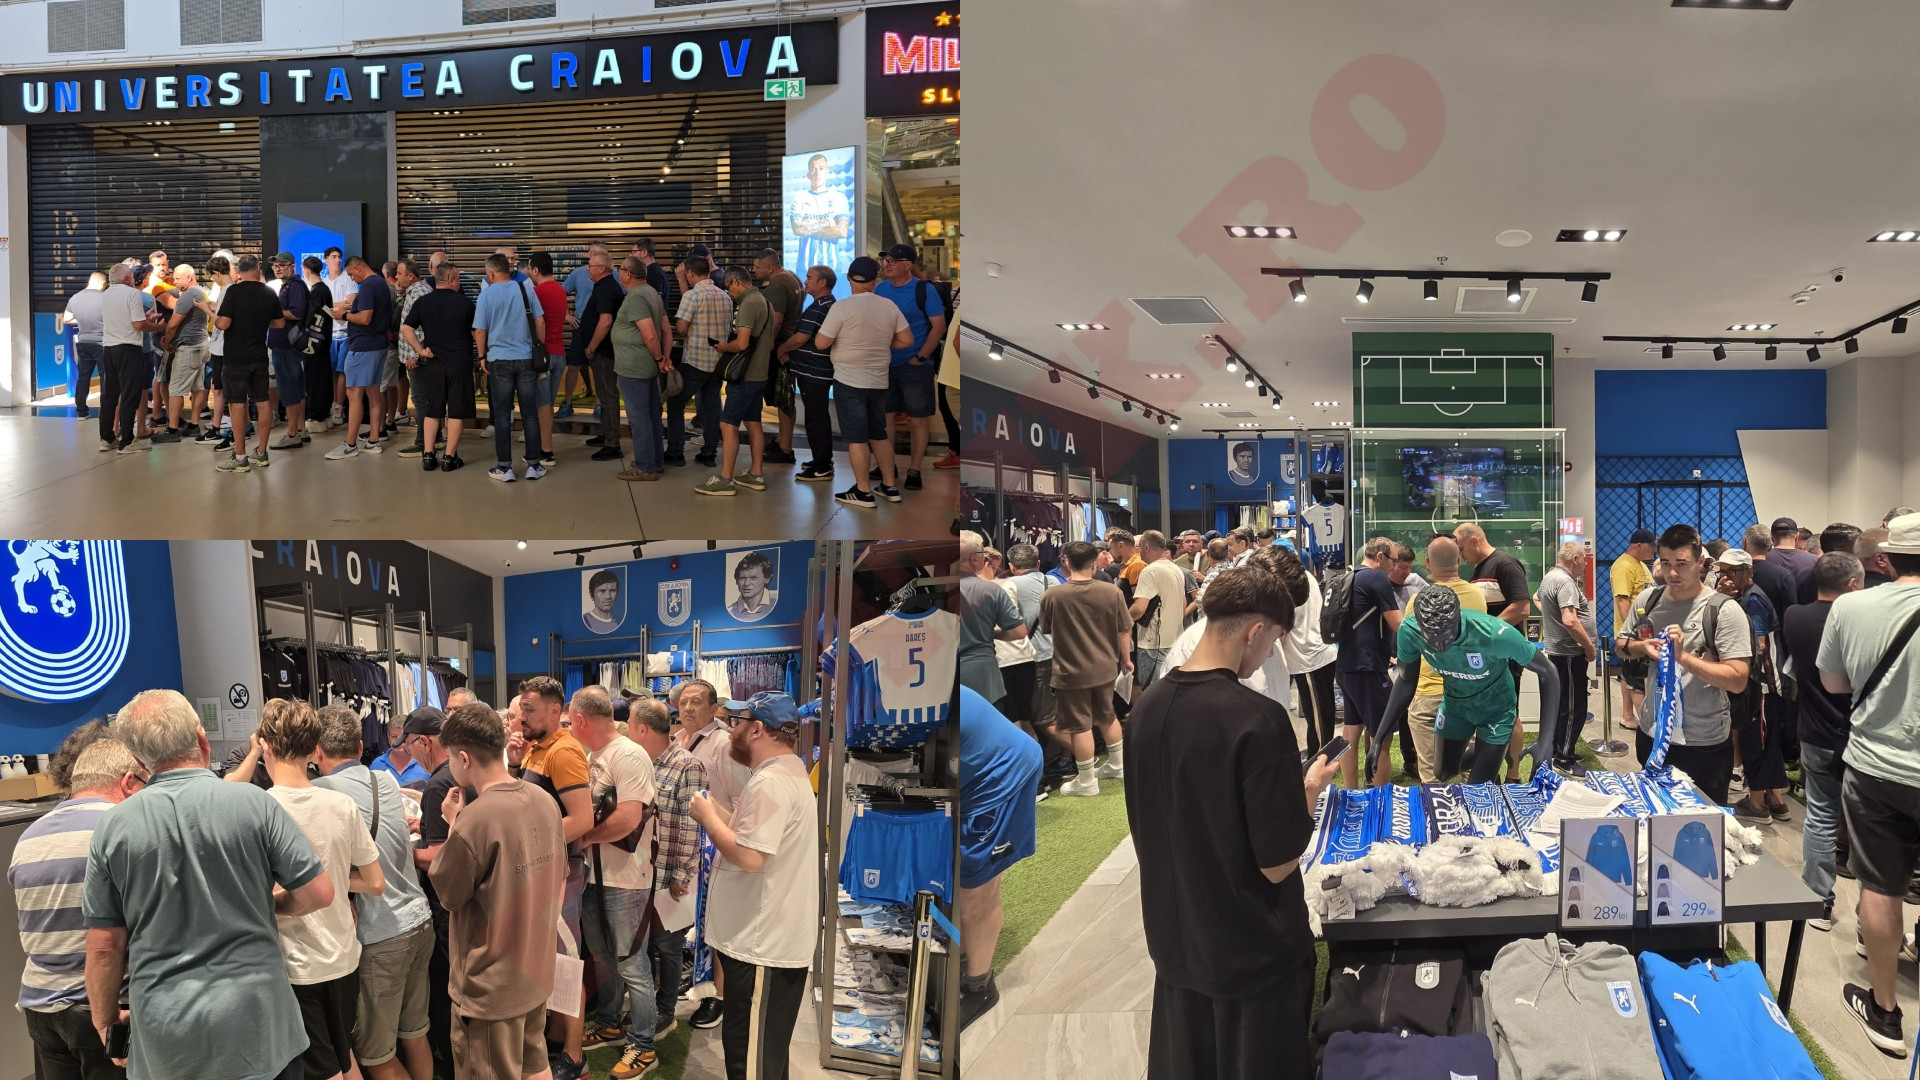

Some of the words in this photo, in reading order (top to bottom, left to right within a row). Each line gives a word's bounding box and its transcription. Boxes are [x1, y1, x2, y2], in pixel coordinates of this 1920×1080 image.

[22, 60, 464, 114] UNIVERSITATEA
[509, 36, 800, 92] CRAIOVA
[921, 87, 960, 104] SL
[960, 405, 1077, 455] RAIOVA
[1325, 519, 1333, 537] 5
[909, 647, 925, 688] 5
[1594, 906, 1619, 920] 289
[1619, 911, 1628, 920] lei
[1682, 902, 1707, 917] 299
[1707, 908, 1716, 916] lei
